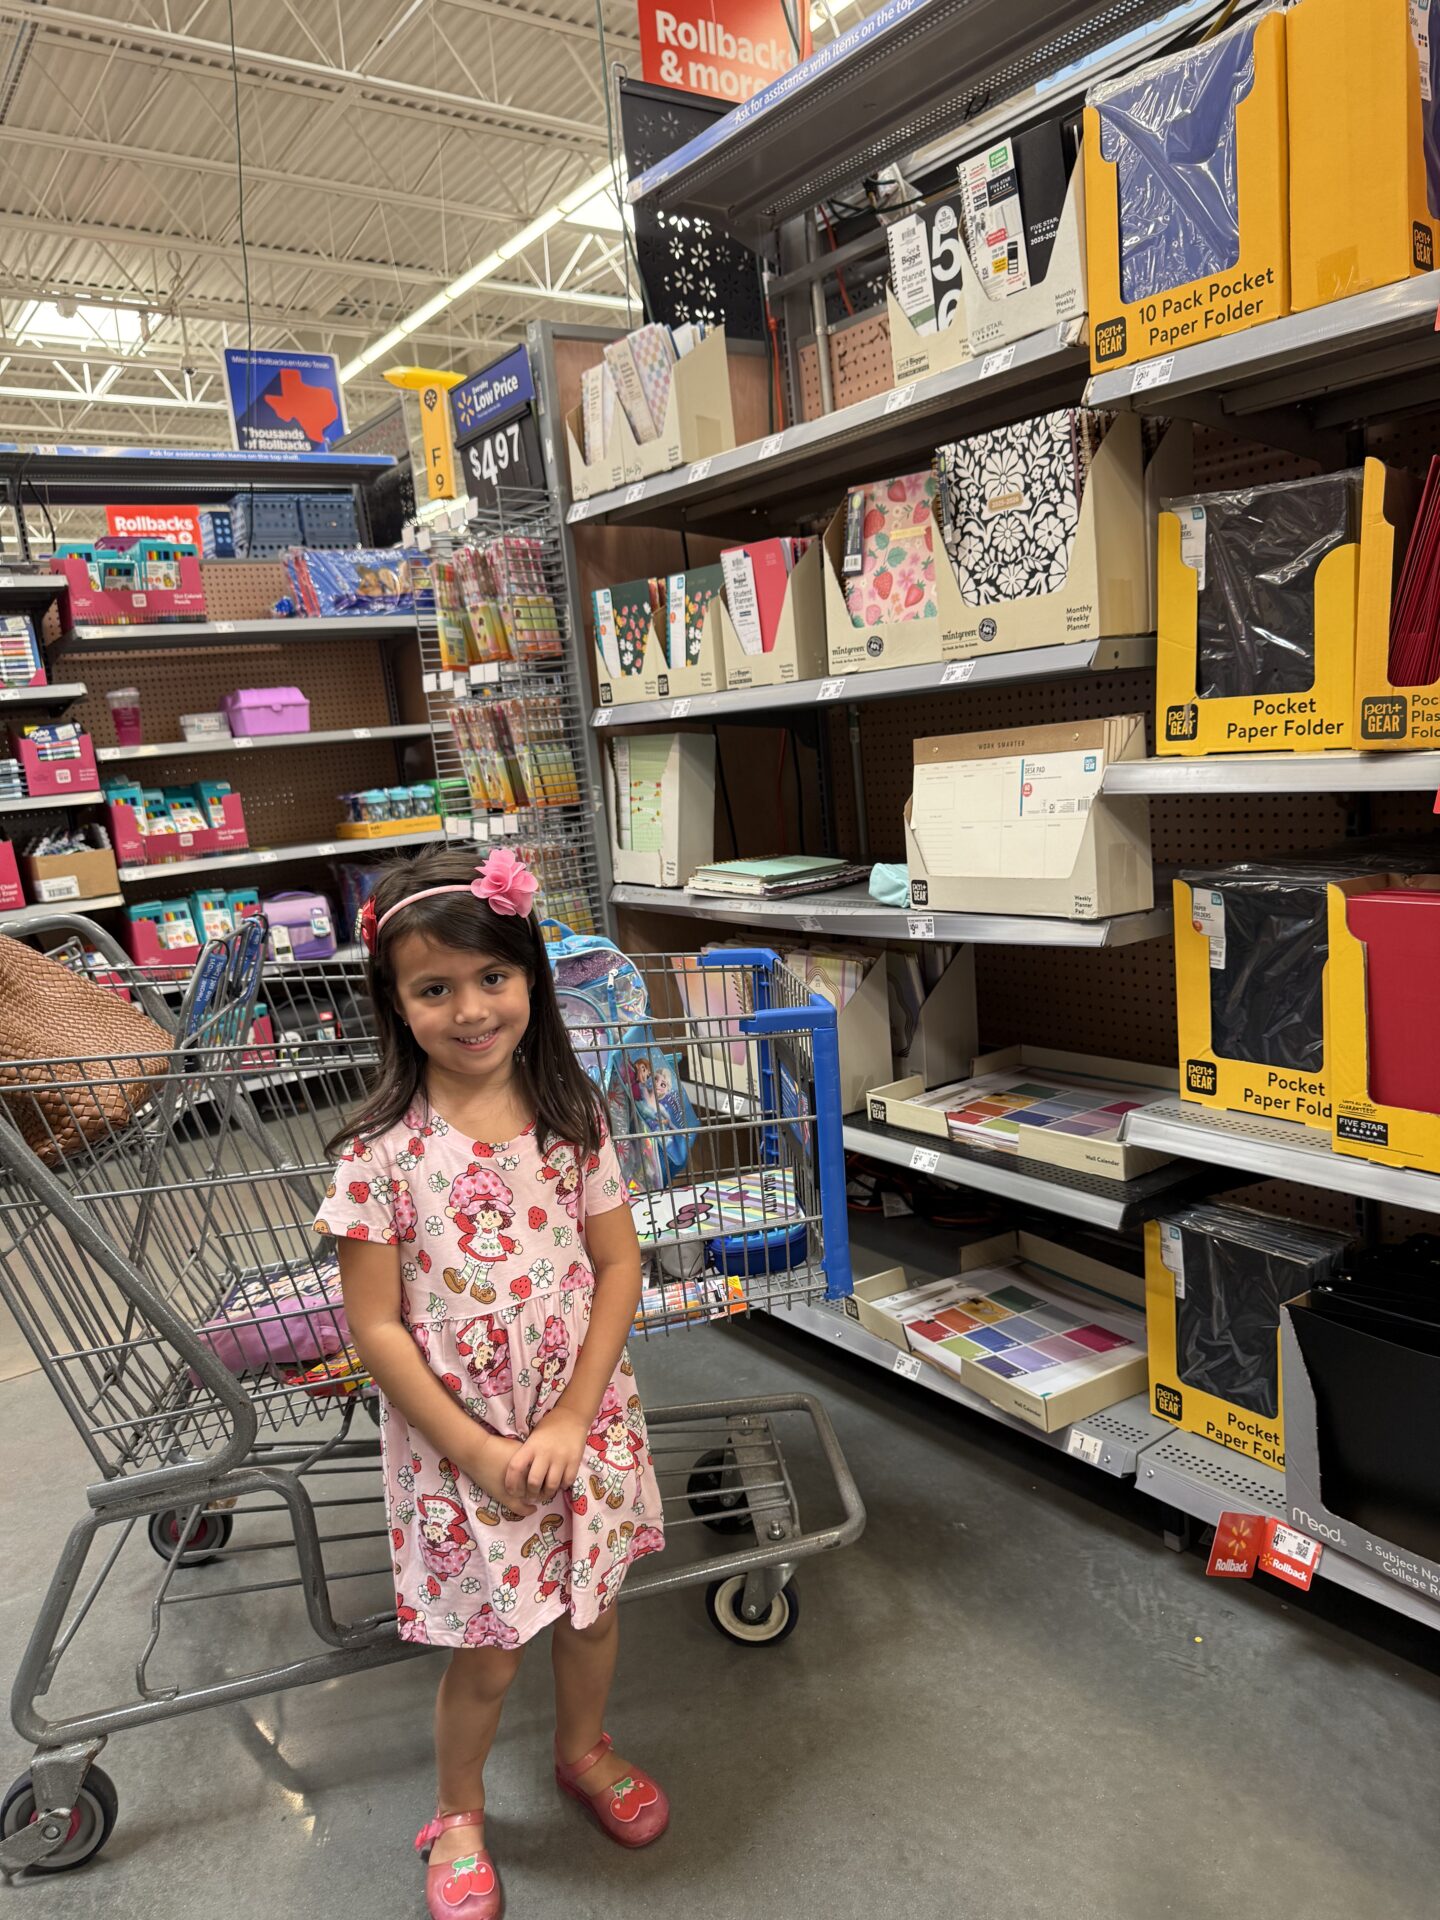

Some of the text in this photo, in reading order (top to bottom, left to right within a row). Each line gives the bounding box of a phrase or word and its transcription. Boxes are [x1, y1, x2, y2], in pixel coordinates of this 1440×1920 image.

[660, 50, 684, 85] &
[734, 0, 916, 125] Ask for assistance with items on the top
[1030, 221, 1043, 231] FIVE
[901, 252, 921, 266] Bigger
[1416, 245, 1432, 264] GEAR
[901, 269, 926, 285] Planner
[1055, 288, 1077, 301] Monthly
[1056, 297, 1074, 308] Weekly
[1139, 267, 1274, 324] 10 Pack Pocket
[1056, 304, 1076, 315] Planner
[1150, 299, 1263, 345] Paper Folder
[1100, 336, 1122, 357] GEAR
[472, 380, 488, 395] Everyday
[473, 389, 493, 412] Low
[493, 375, 518, 401] Price
[242, 427, 305, 440] Thousands
[258, 440, 311, 451] Rollbacks
[432, 447, 441, 468] F
[435, 474, 444, 491] 9
[114, 516, 194, 531] Rollbacks
[733, 589, 752, 598] Student
[734, 597, 753, 606] Planner
[1066, 605, 1092, 615] Monthly
[1066, 614, 1090, 623] Weekly
[1067, 623, 1090, 631] Planner
[942, 630, 977, 642] mintgreen
[832, 646, 864, 656] mintgreen
[1253, 698, 1316, 716] Pocket
[1412, 694, 1440, 706] Poc
[1364, 703, 1402, 720] pen+
[1412, 711, 1440, 722] Plas
[1170, 719, 1194, 737] GEAR
[1226, 719, 1344, 745] Paper Folder
[1368, 715, 1400, 733] GEAR
[998, 740, 1025, 749] SMARTER
[1036, 766, 1046, 774] PAD
[1188, 1063, 1214, 1081] pen+
[1190, 1075, 1213, 1091] GEAR
[1268, 1072, 1325, 1097] Pocket
[1243, 1089, 1332, 1119] Paper Fold
[872, 1110, 886, 1120] GEAR
[1339, 1117, 1359, 1127] FIVE
[1097, 1157, 1120, 1166] Calendar
[1159, 1398, 1179, 1416] GEAR
[1228, 1412, 1279, 1446] Pocket
[1206, 1421, 1285, 1467] Paper Fold
[1215, 1558, 1249, 1573] Rollback
[1365, 1540, 1373, 1551] 3
[1375, 1545, 1419, 1575] Subject
[1272, 1558, 1308, 1582] Rollback
[1383, 1561, 1427, 1590] College
